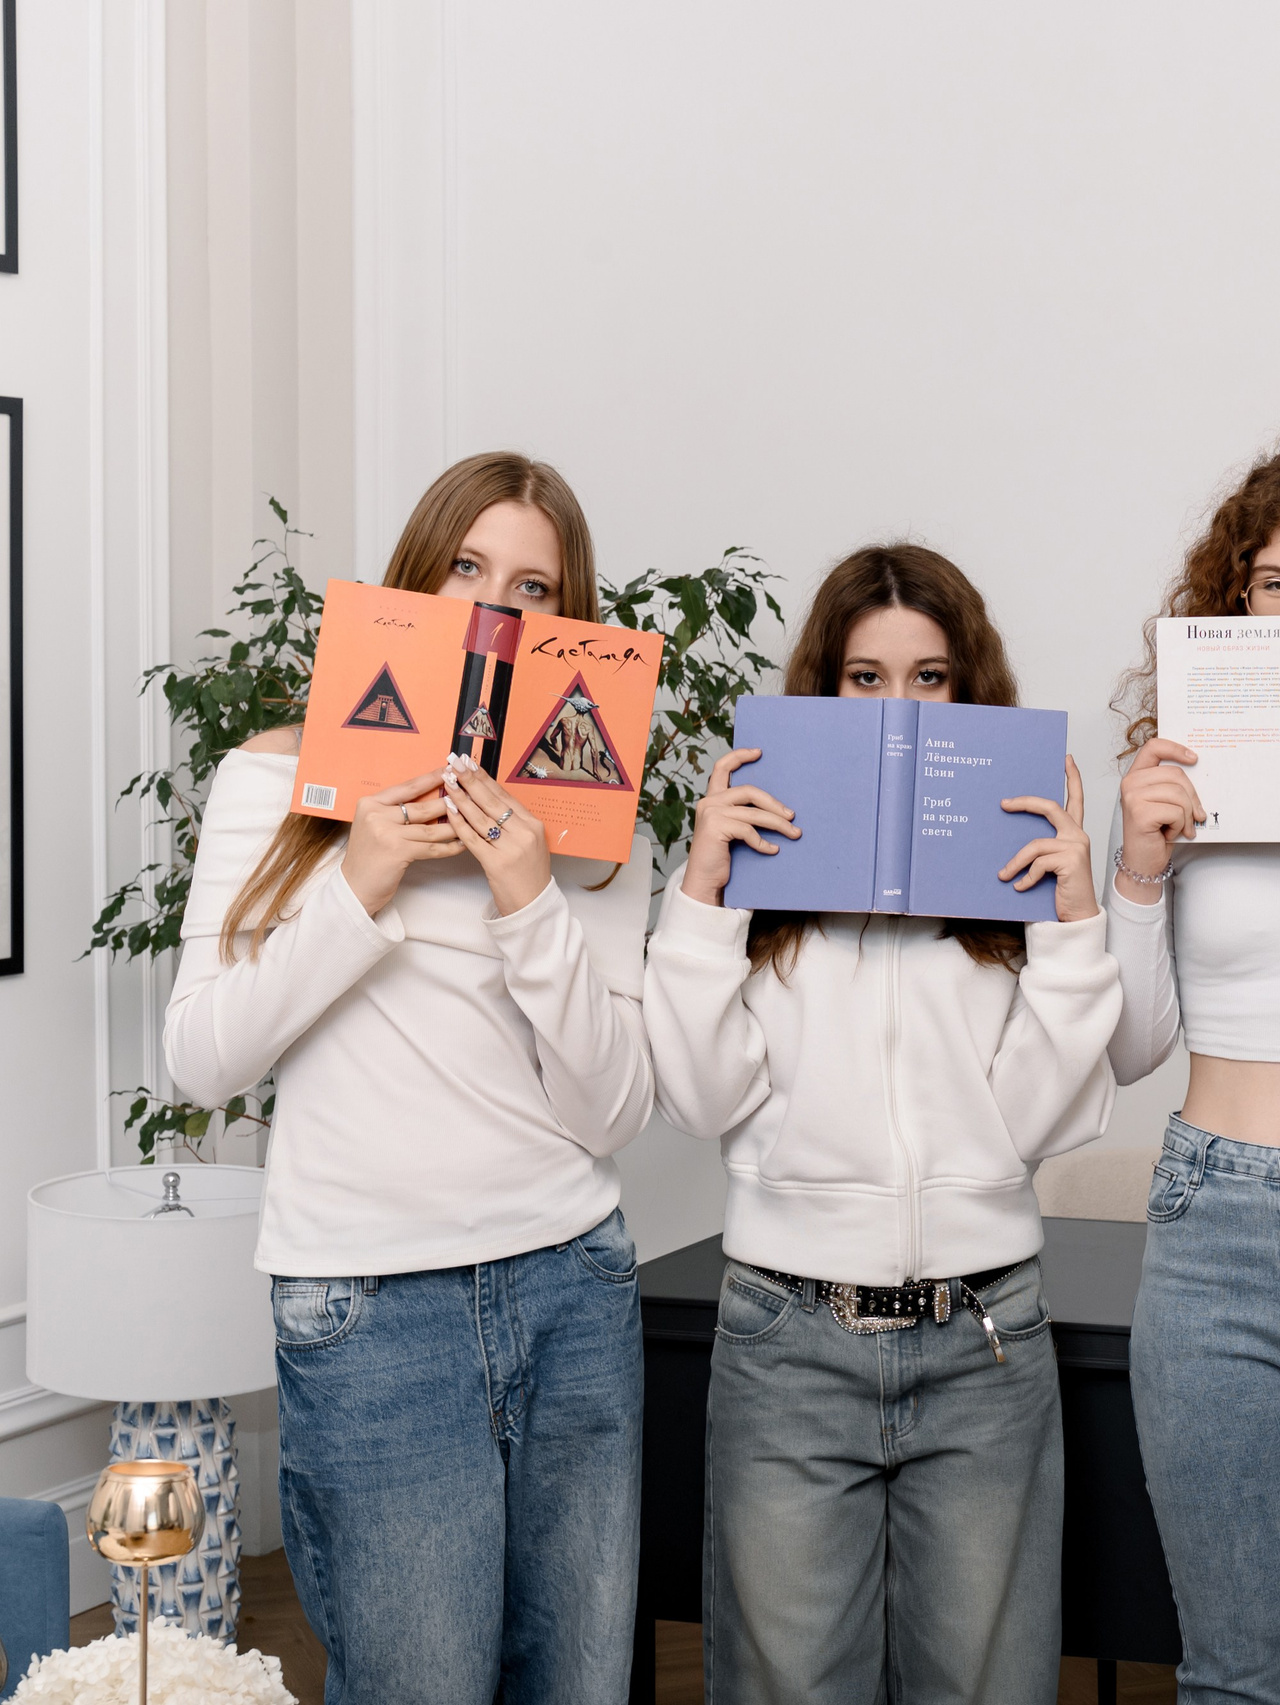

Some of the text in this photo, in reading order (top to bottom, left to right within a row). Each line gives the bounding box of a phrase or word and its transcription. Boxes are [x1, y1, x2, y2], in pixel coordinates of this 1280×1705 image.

[1187, 625, 1280, 640] Новая земля
[925, 738, 955, 749] Анна
[924, 752, 993, 767] Лёвенхаупт
[924, 767, 955, 778] Цзин
[923, 796, 952, 809] Гриб
[922, 813, 968, 824] на краю
[922, 828, 953, 837] света
